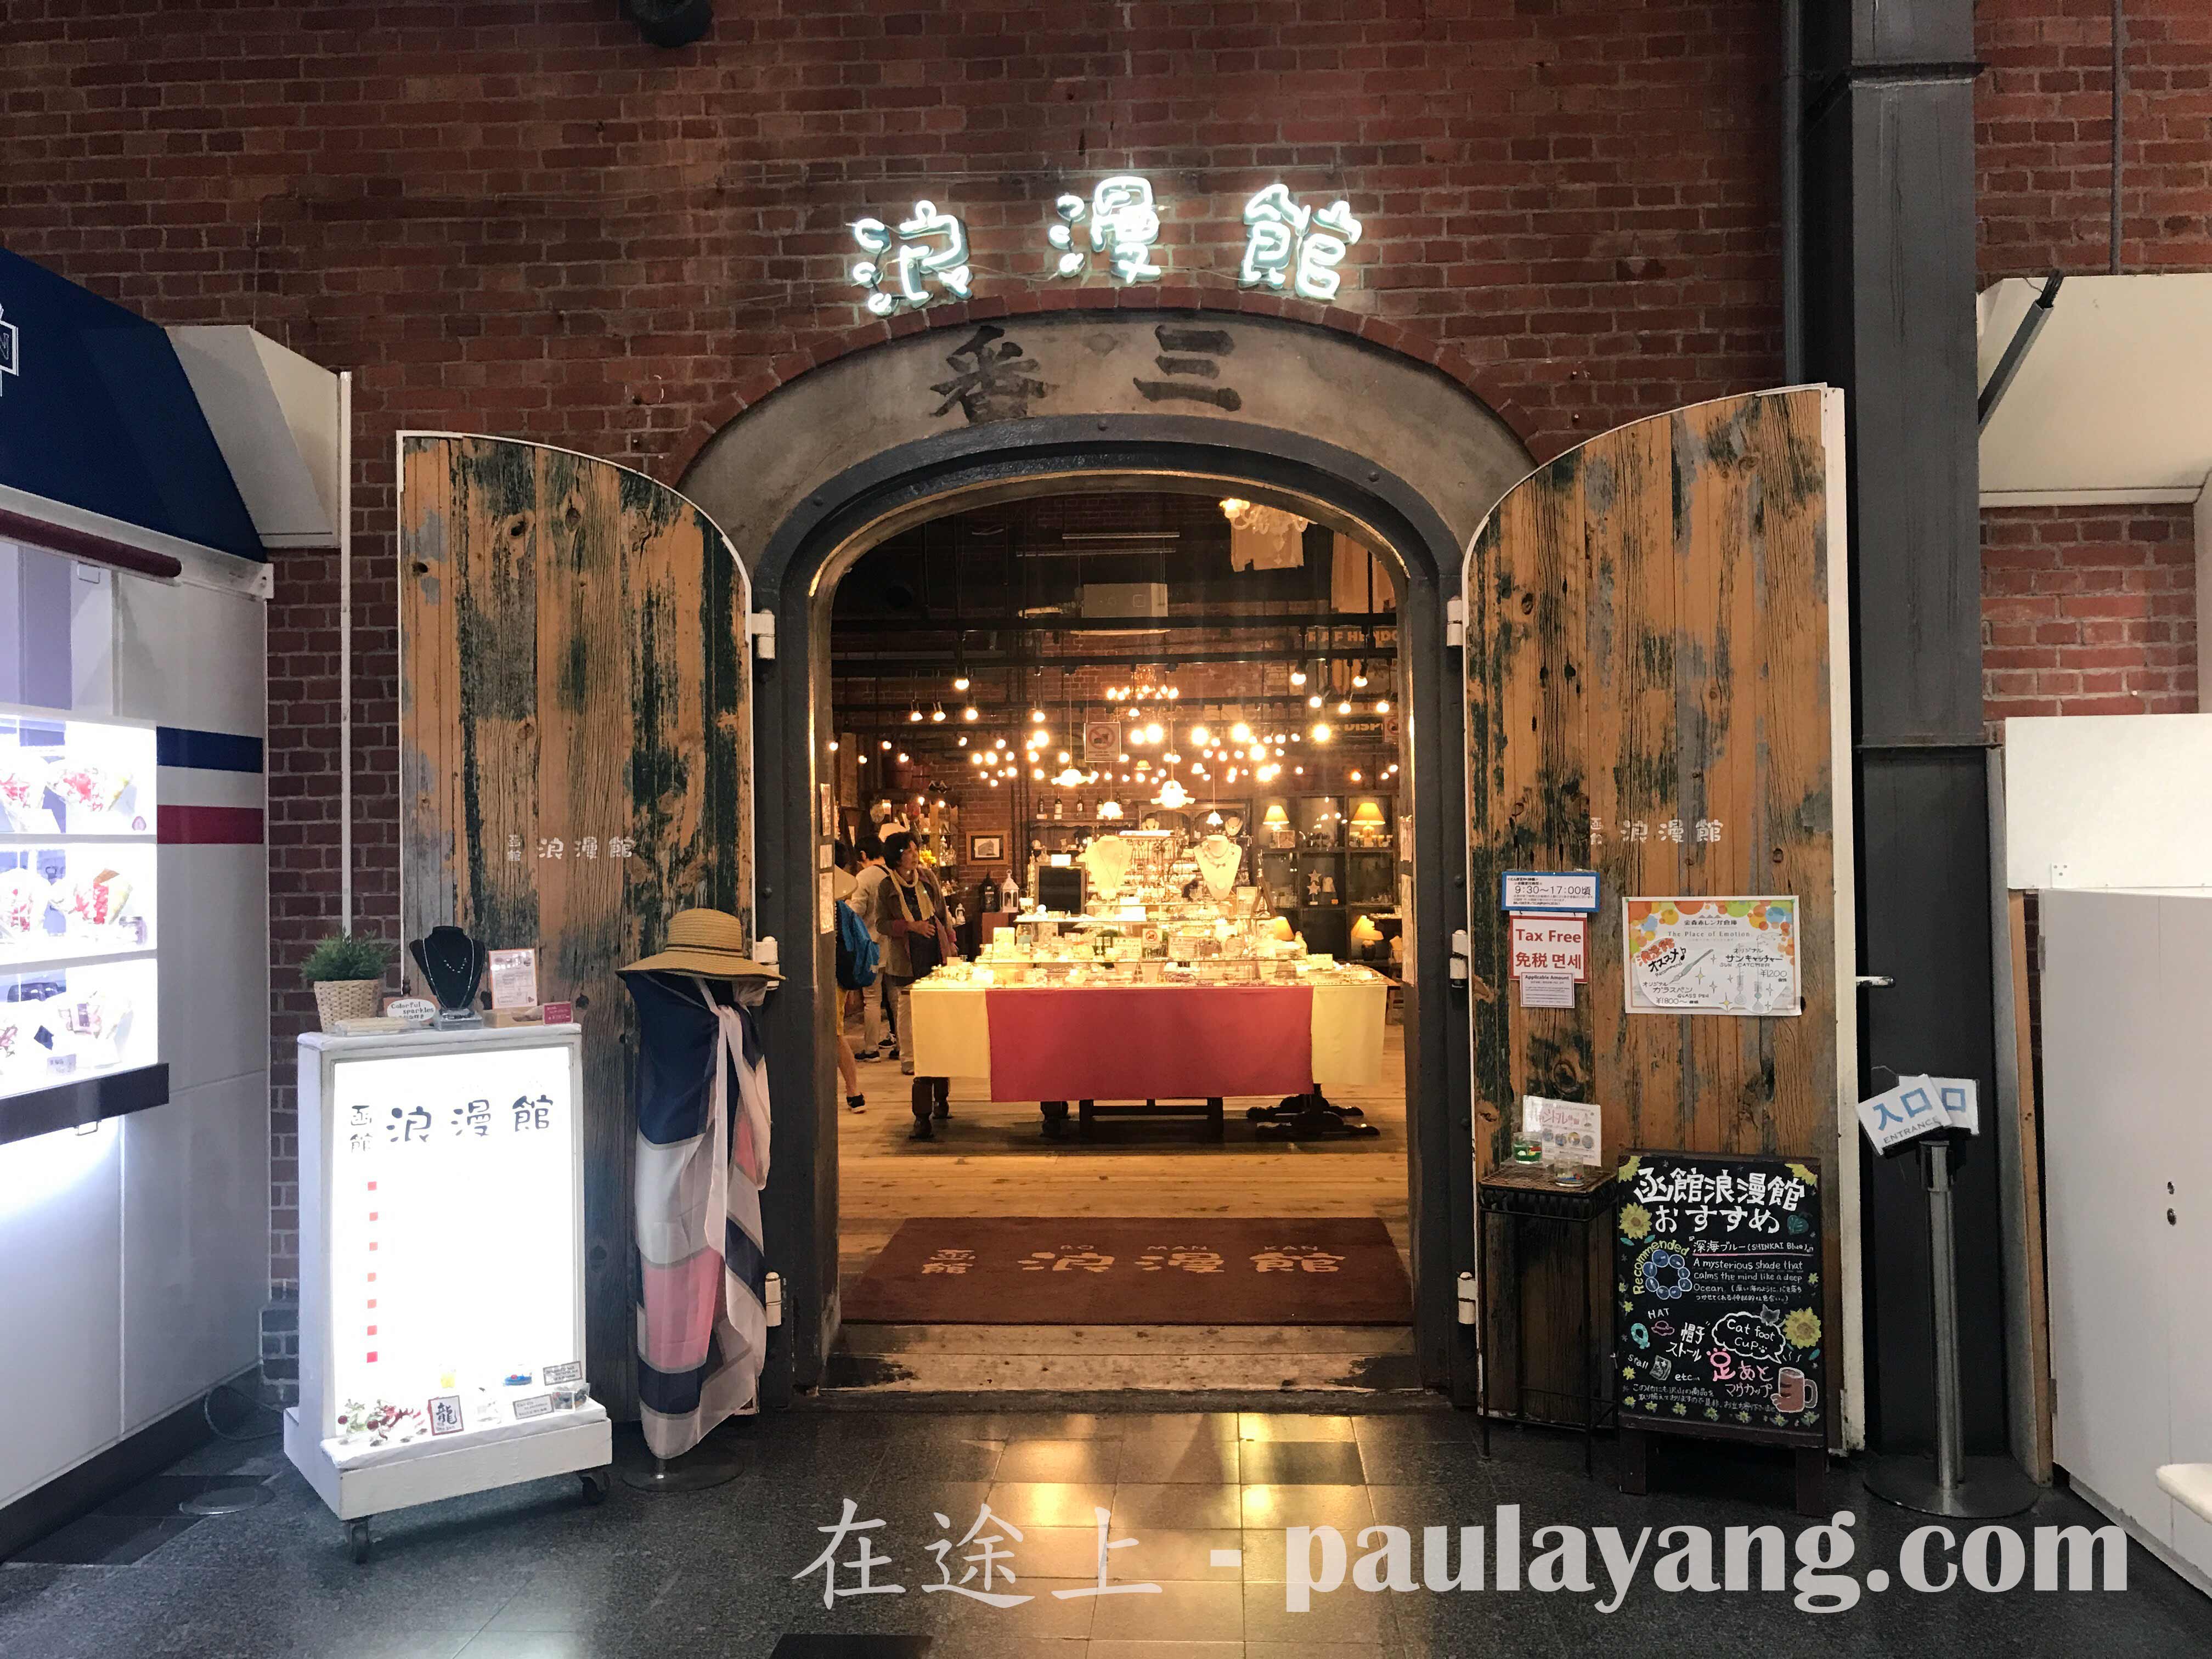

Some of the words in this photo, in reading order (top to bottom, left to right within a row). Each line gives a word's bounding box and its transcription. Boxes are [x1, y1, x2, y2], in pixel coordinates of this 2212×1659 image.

[852, 176, 1362, 315] 浪漫館
[1620, 819, 1724, 844] 浪漫館
[537, 836, 636, 860] 浪漫館
[1515, 928, 1543, 942] Tax
[1548, 930, 1582, 943] Free
[1515, 951, 1548, 968] 免税
[1551, 953, 1581, 970] 면세
[1760, 969, 1787, 978] ¥1200
[386, 1094, 554, 1143] 浪漫館
[1872, 1087, 1933, 1131] 入口
[1883, 1115, 1942, 1144] ENTRANCE
[1633, 1167, 1805, 1211] 函館浪漫館
[1655, 1205, 1780, 1233] おすすめ
[1017, 1251, 1347, 1273] 浪漫館
[1633, 1239, 1690, 1295] Recommended
[1693, 1257, 1700, 1267] A
[1702, 1260, 1753, 1271] mysterious
[1755, 1260, 1781, 1270] shade
[1783, 1260, 1803, 1270] that
[1693, 1283, 1724, 1293] Ocean
[1694, 1271, 1718, 1280] calms
[1720, 1272, 1735, 1280] the
[1760, 1272, 1774, 1280] like
[1783, 1273, 1803, 1284] deep
[1647, 1308, 1670, 1319] HAT
[1680, 1322, 1706, 1344] 帽子
[1726, 1318, 1751, 1335] Cat
[1754, 1325, 1777, 1342] foot
[1666, 1341, 1702, 1363] ストール
[1706, 1347, 1774, 1382] 足あと
[1724, 1383, 1774, 1398] マグカップ
[436, 1402, 458, 1424] 龍
